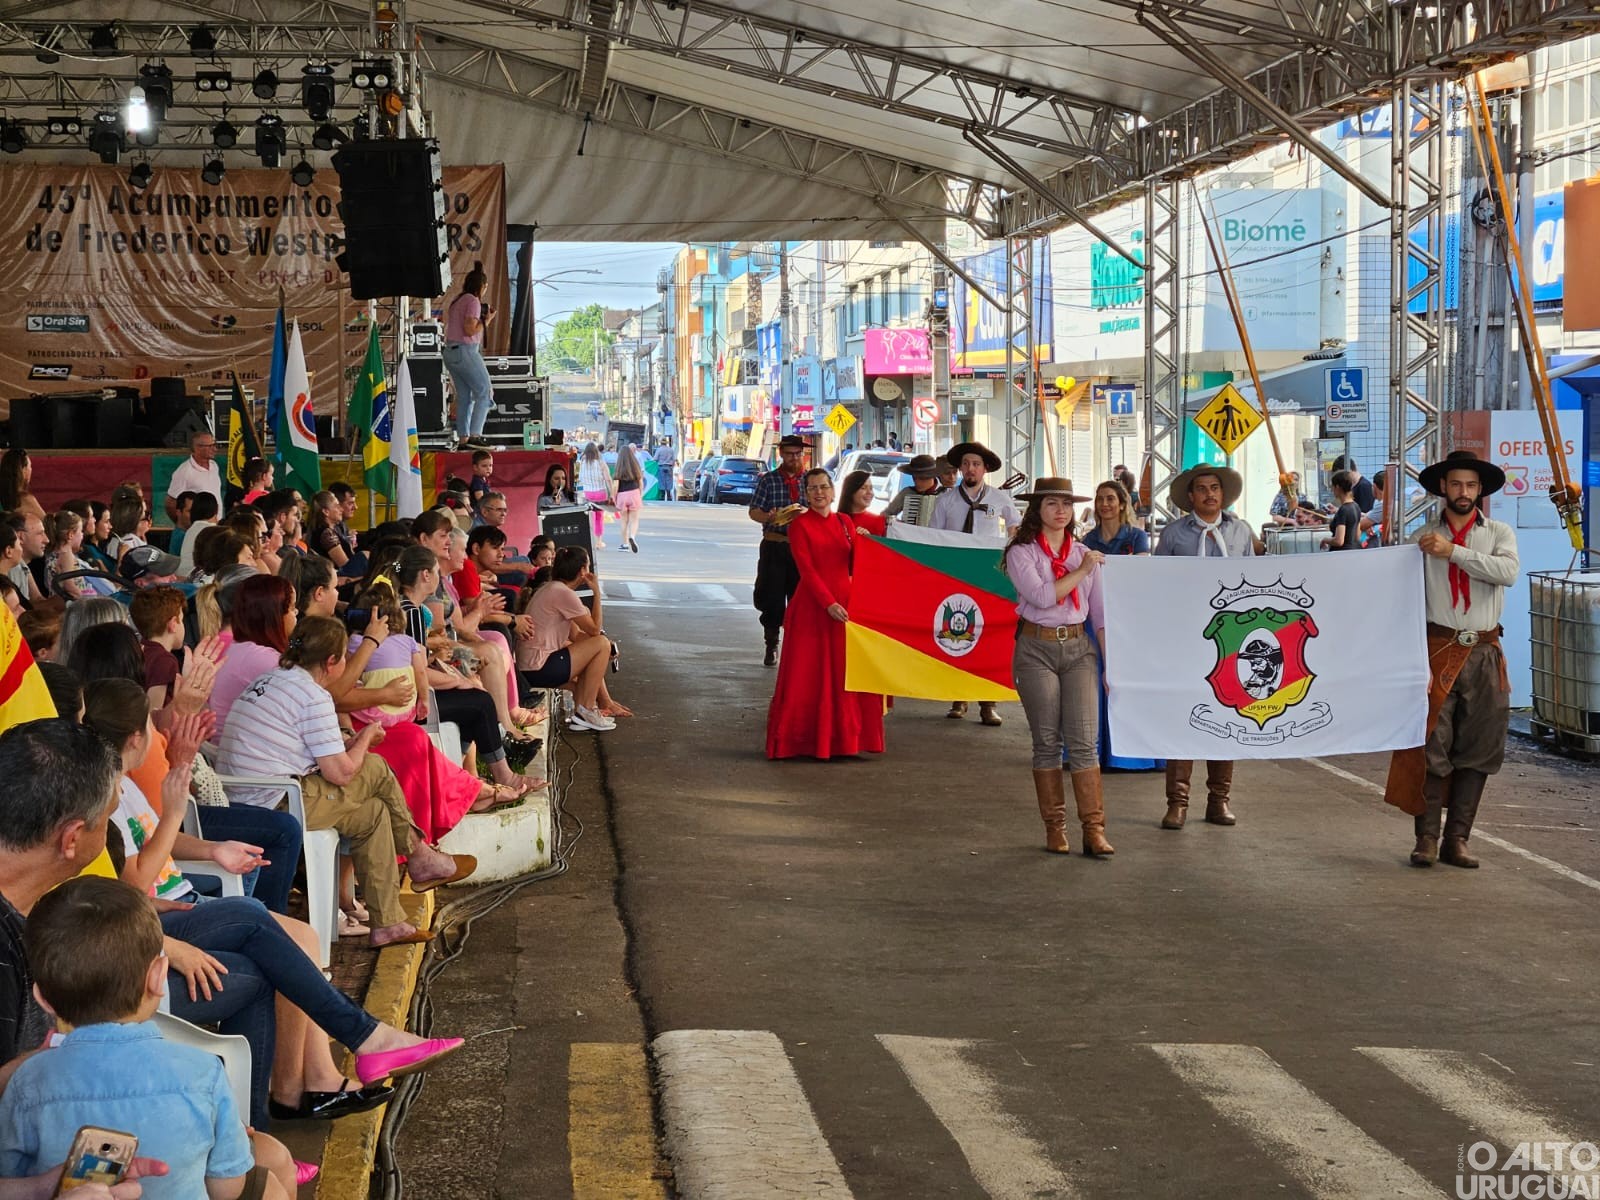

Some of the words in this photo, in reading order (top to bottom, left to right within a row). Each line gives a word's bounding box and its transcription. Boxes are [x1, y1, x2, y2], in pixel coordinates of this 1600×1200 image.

[106, 183, 333, 224] Acampamento
[26, 223, 63, 252] de
[78, 223, 231, 256] Frederico
[245, 226, 341, 262] Westp
[208, 270, 236, 284] SET
[44, 317, 67, 326] Oral
[69, 317, 86, 326] Sin
[27, 350, 97, 358] PATROCINADORES
[1500, 441, 1574, 456] OFERTS
[1277, 589, 1299, 600] NUNES
